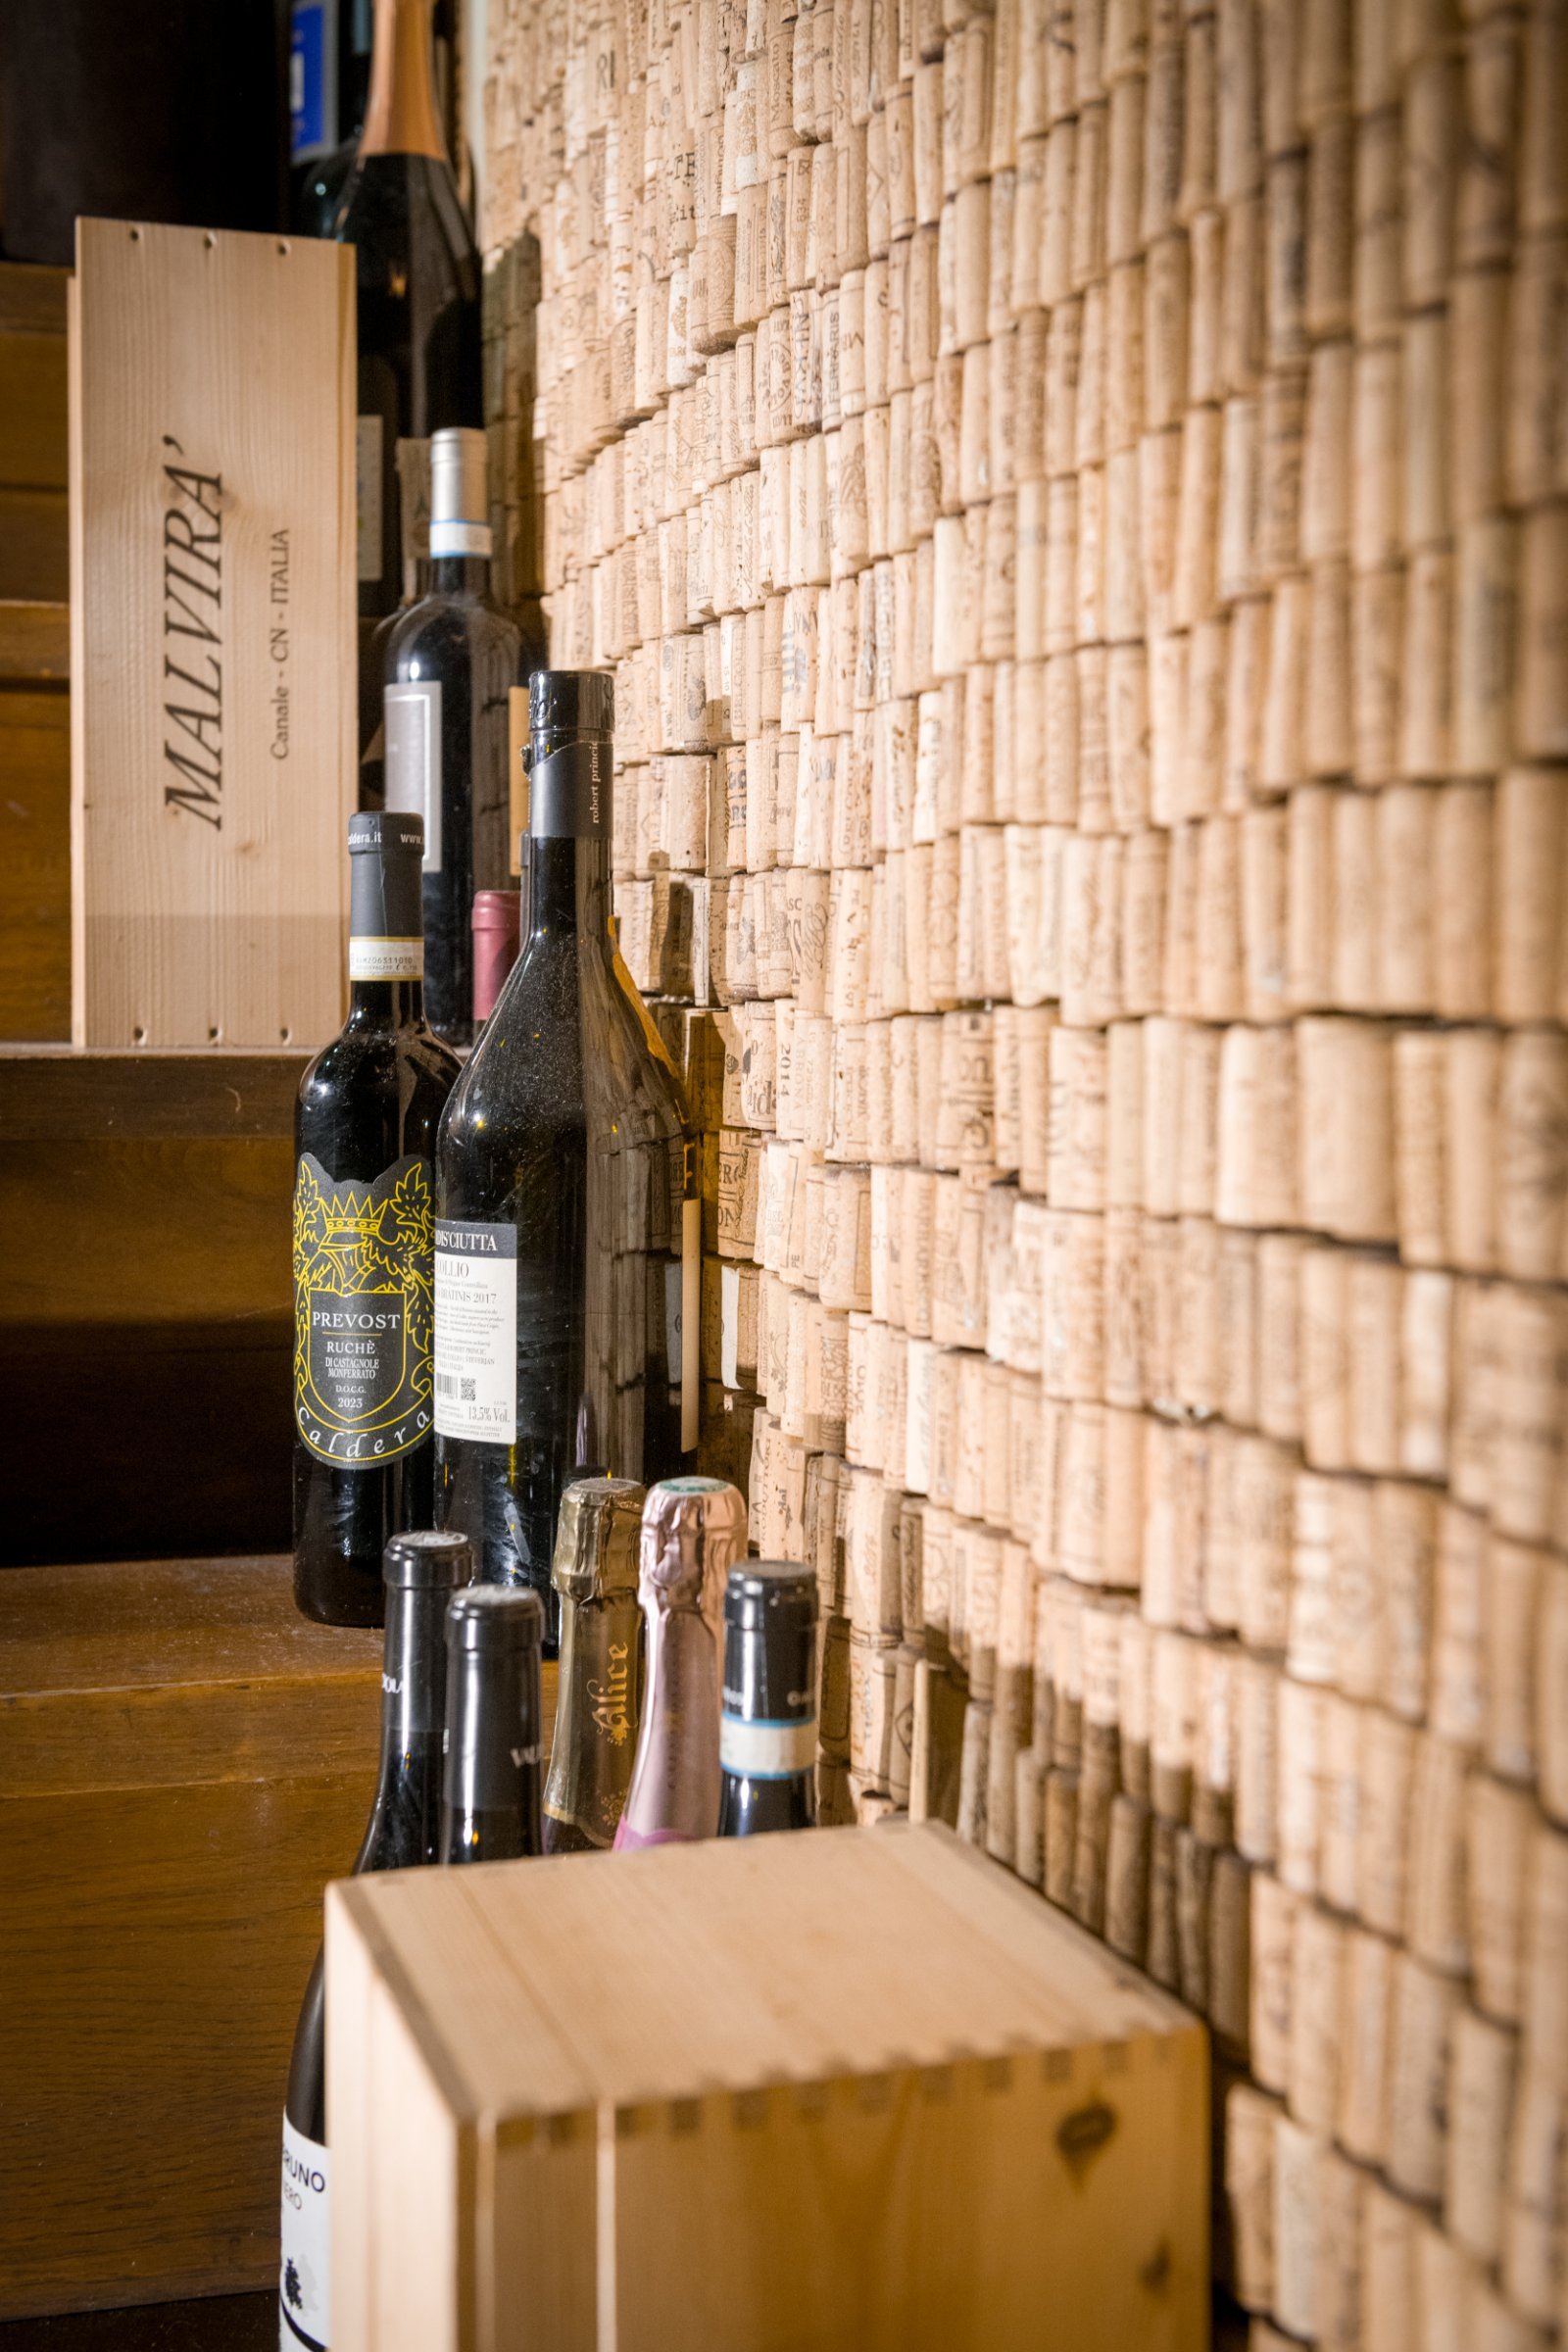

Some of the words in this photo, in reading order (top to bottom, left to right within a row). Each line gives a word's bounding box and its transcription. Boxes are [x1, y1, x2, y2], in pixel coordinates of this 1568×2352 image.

[770, 42, 781, 123] Moscato
[270, 528, 290, 605] ITALIA
[163, 433, 223, 832] MALVIRA'
[270, 627, 290, 662] CN
[270, 685, 290, 760] Canale
[589, 785, 600, 824] robert
[780, 1043, 792, 1098] 2014
[435, 1229, 498, 1251] DIS'CIUTTA
[436, 1257, 469, 1278] OLLIO
[473, 1293, 497, 1304] 2017
[312, 1310, 401, 1330] PREVOST
[325, 1356, 333, 1367] DI
[333, 1357, 380, 1370] CASTAGNOLE
[326, 1339, 376, 1354] RUCHÈ
[327, 1369, 376, 1380] MONFERRATO
[335, 1385, 367, 1395] D.O.C.G.
[337, 1397, 364, 1409] 2023
[298, 1406, 430, 1458] Caldera
[587, 1641, 638, 1736] Alice
[282, 2147, 325, 2194] RUNO
